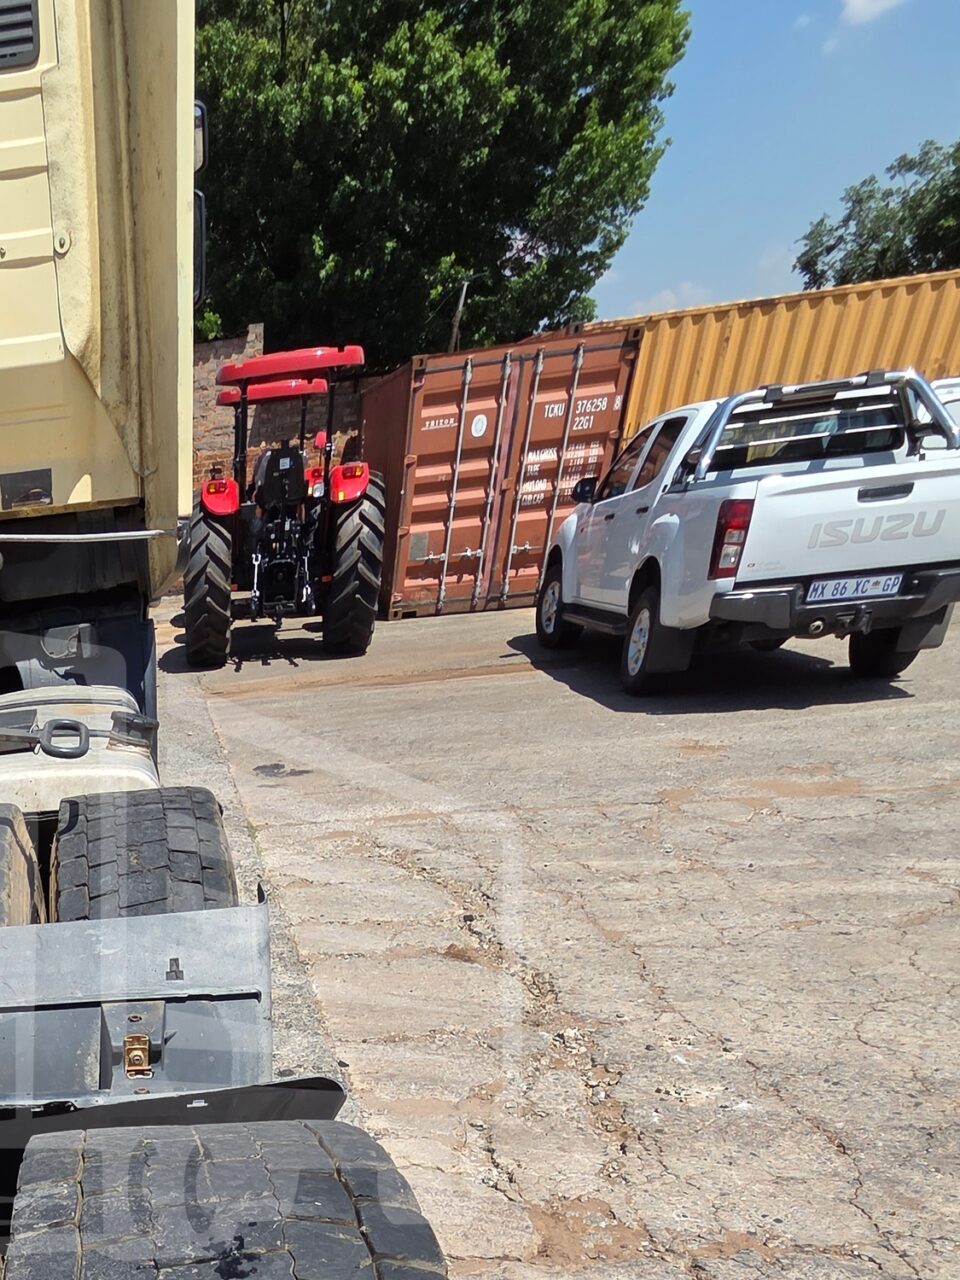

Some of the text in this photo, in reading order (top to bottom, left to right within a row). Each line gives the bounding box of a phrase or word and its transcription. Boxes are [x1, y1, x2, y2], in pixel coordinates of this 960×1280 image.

[544, 402, 565, 418] TCKU
[576, 397, 608, 414] 376258
[573, 415, 594, 430] 22G1
[807, 509, 947, 550] ISUZU
[831, 583, 848, 597] 86
[852, 579, 870, 595] XC
[882, 576, 902, 592] GP
